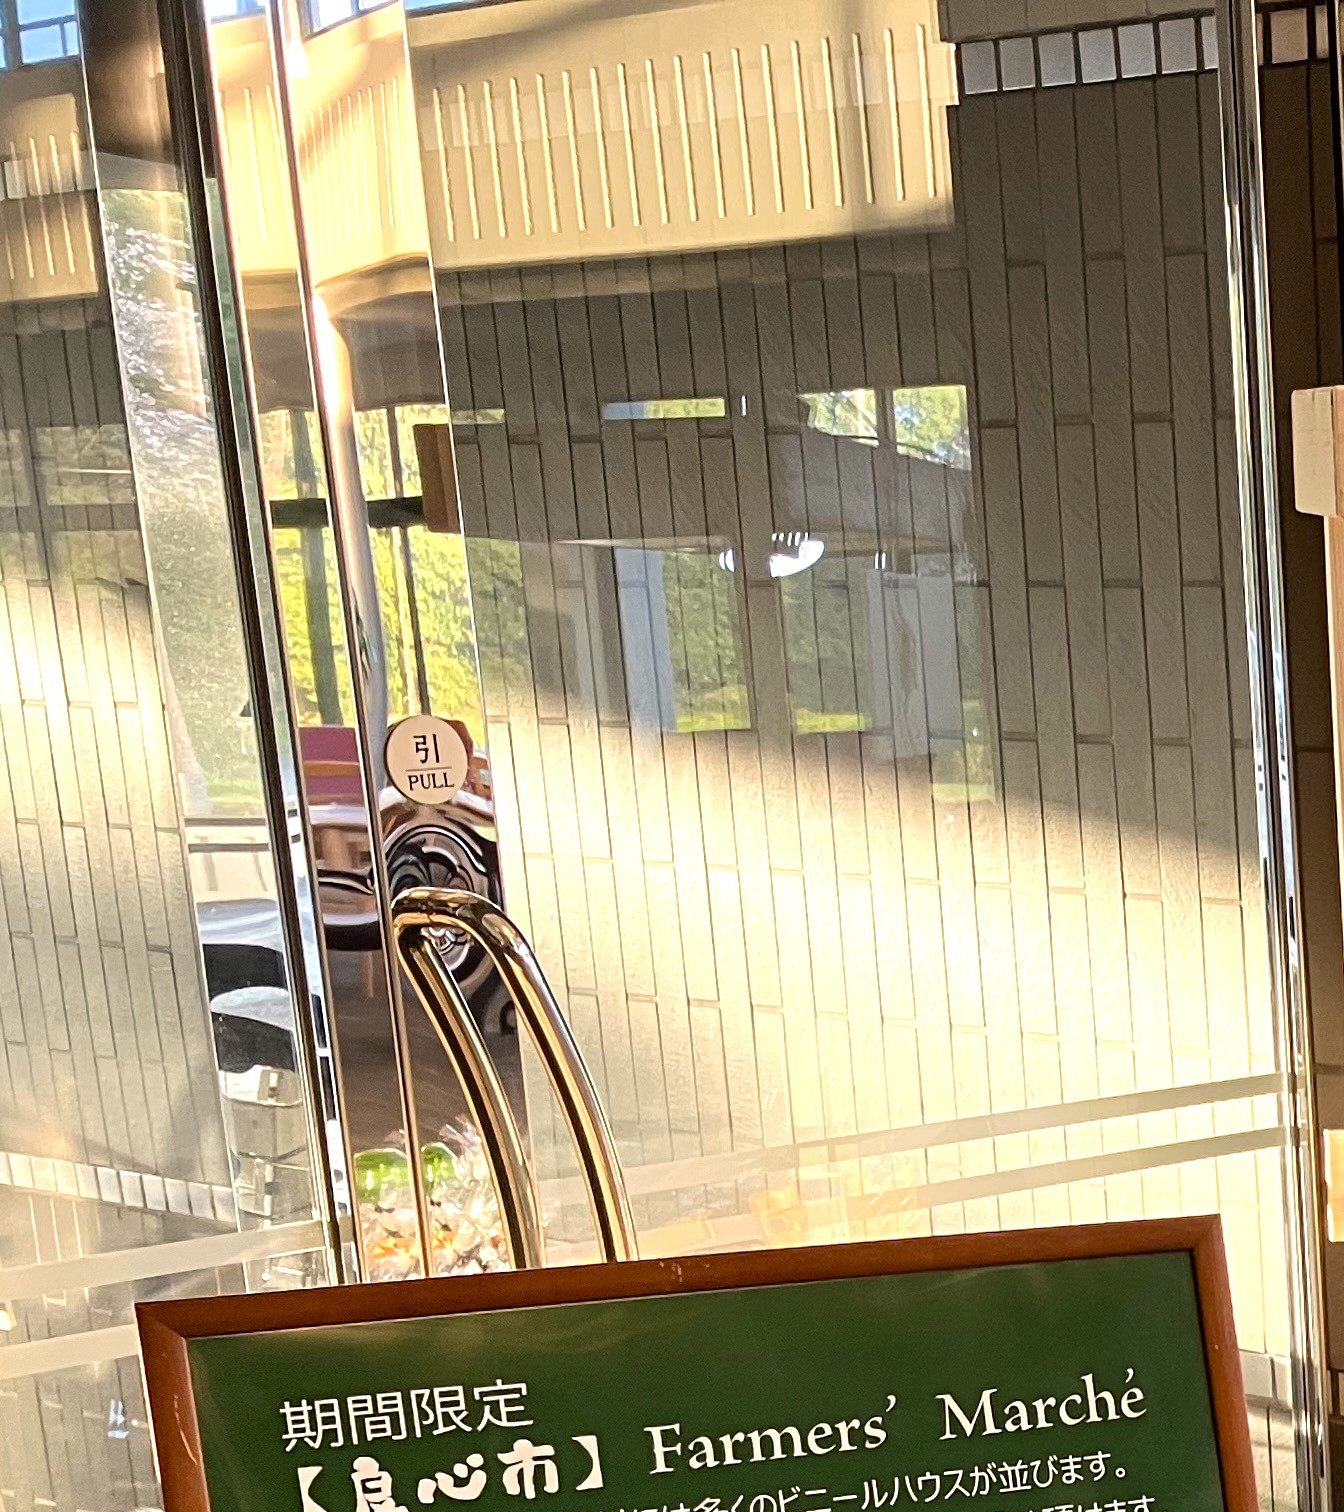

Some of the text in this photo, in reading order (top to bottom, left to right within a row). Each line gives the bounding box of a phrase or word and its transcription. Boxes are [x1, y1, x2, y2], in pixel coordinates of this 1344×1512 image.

[413, 734, 440, 763] 引
[408, 772, 455, 791] PULL
[279, 1378, 534, 1453] 期間限定
[935, 1367, 1148, 1442] Marché
